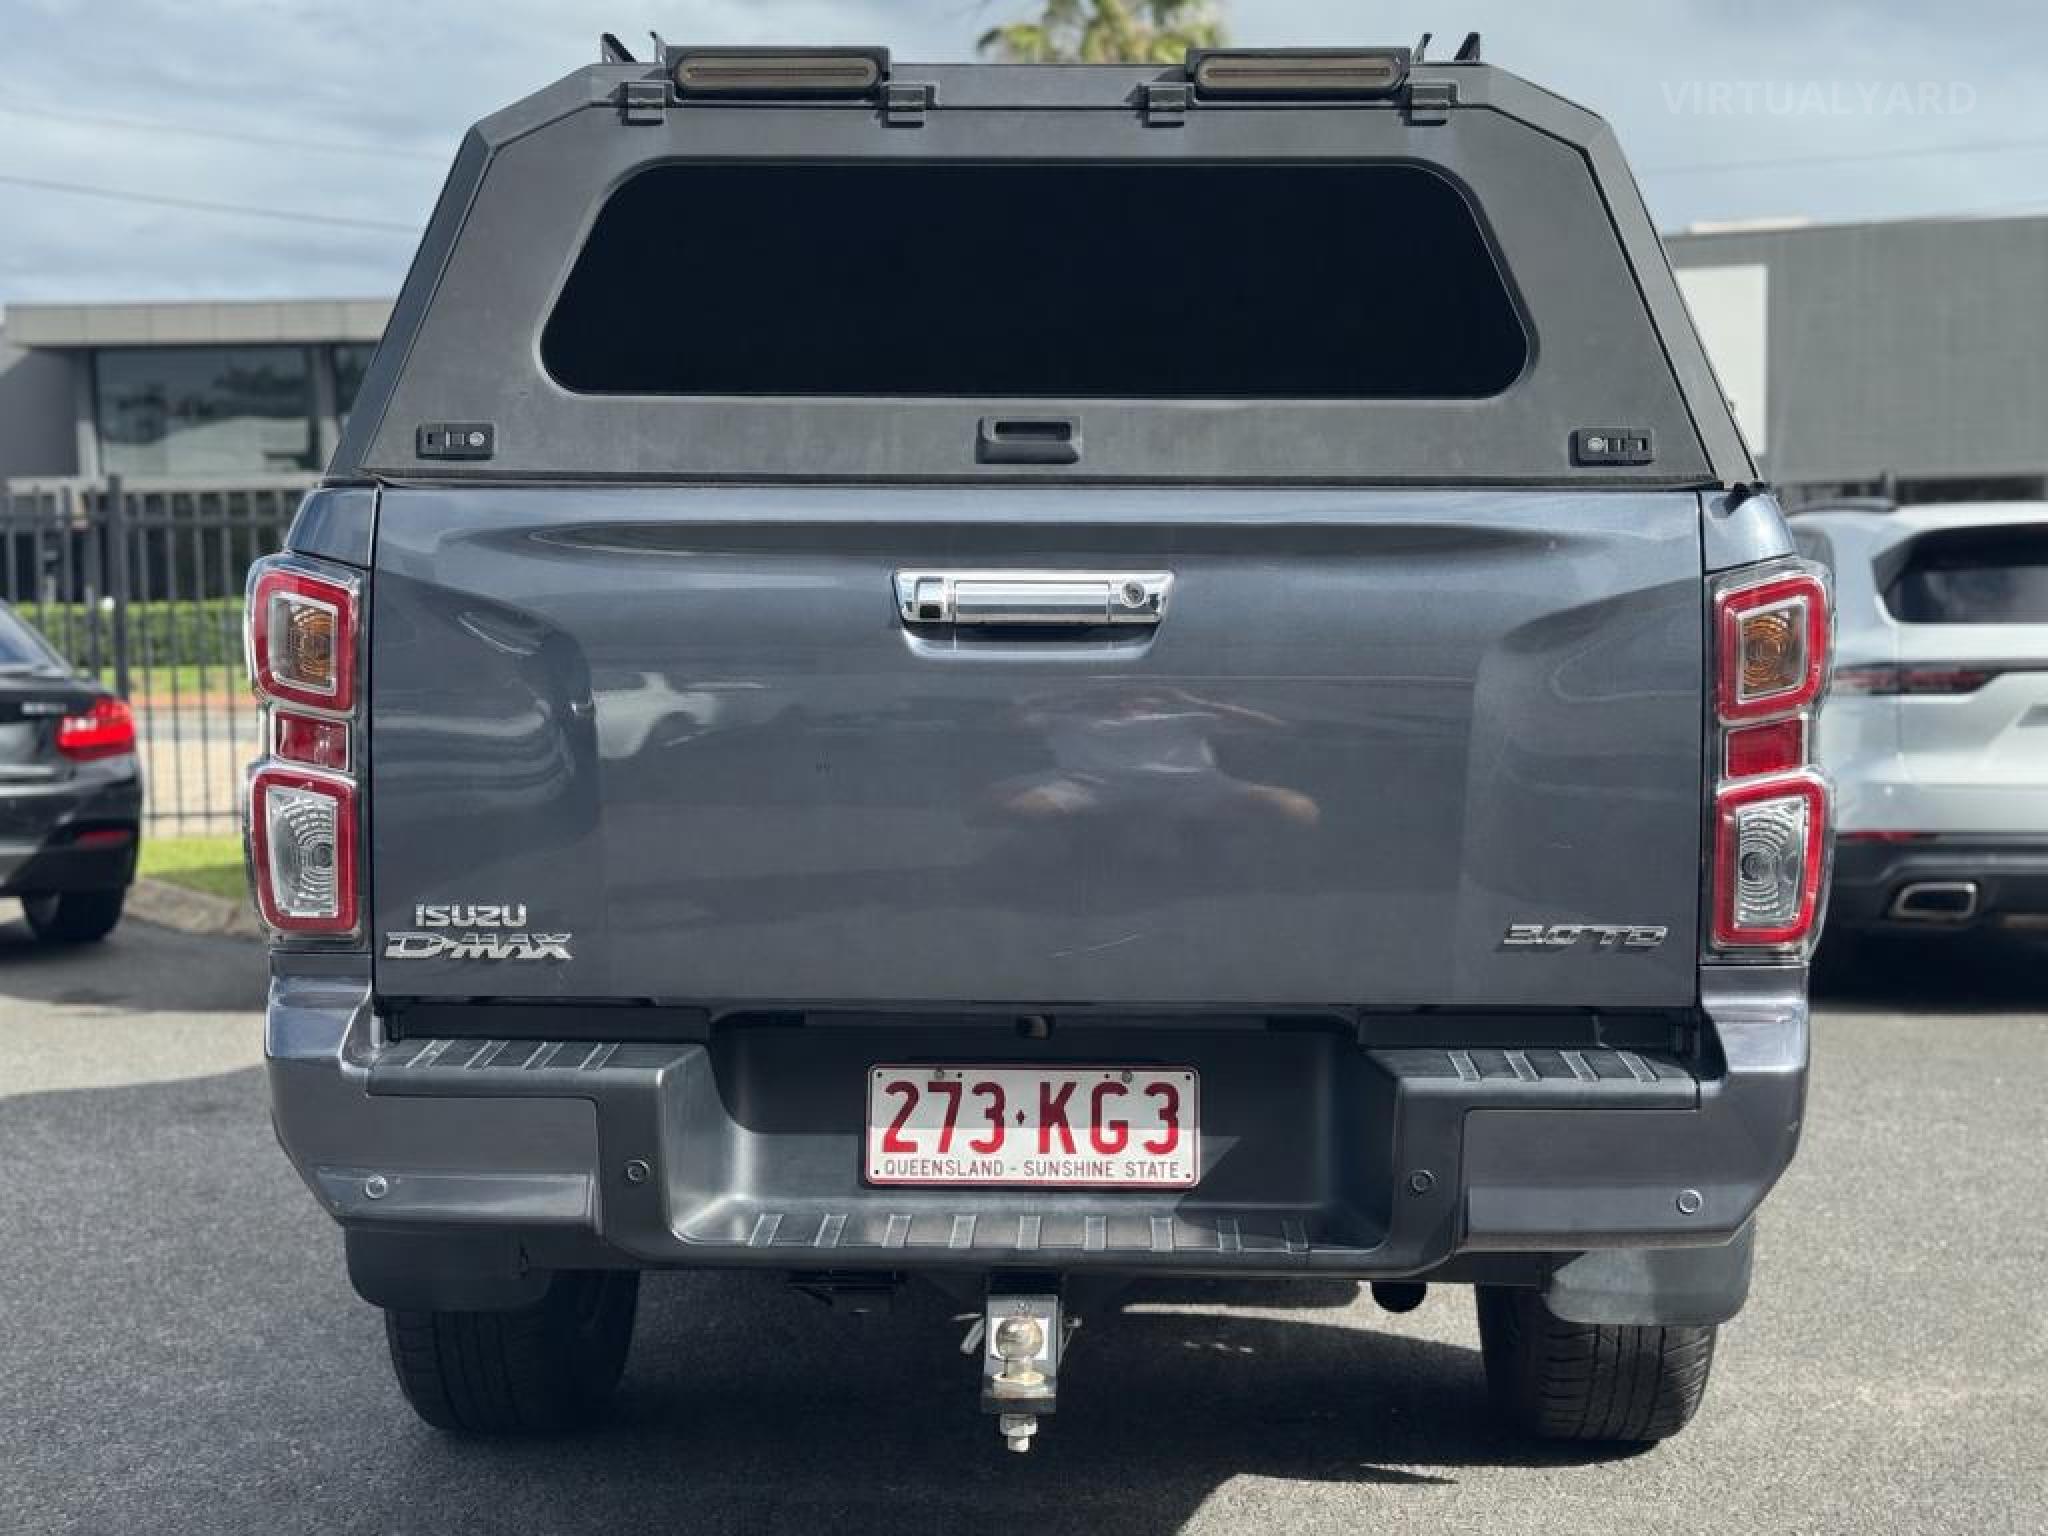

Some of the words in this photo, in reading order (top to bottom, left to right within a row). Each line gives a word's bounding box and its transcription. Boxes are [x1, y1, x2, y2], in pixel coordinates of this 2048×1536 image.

[415, 903, 527, 927] ISUZU
[885, 1159, 1004, 1177] QUEENSLAND
[1024, 1161, 1114, 1178] SUNSHINE
[1125, 1161, 1180, 1178] STATE
